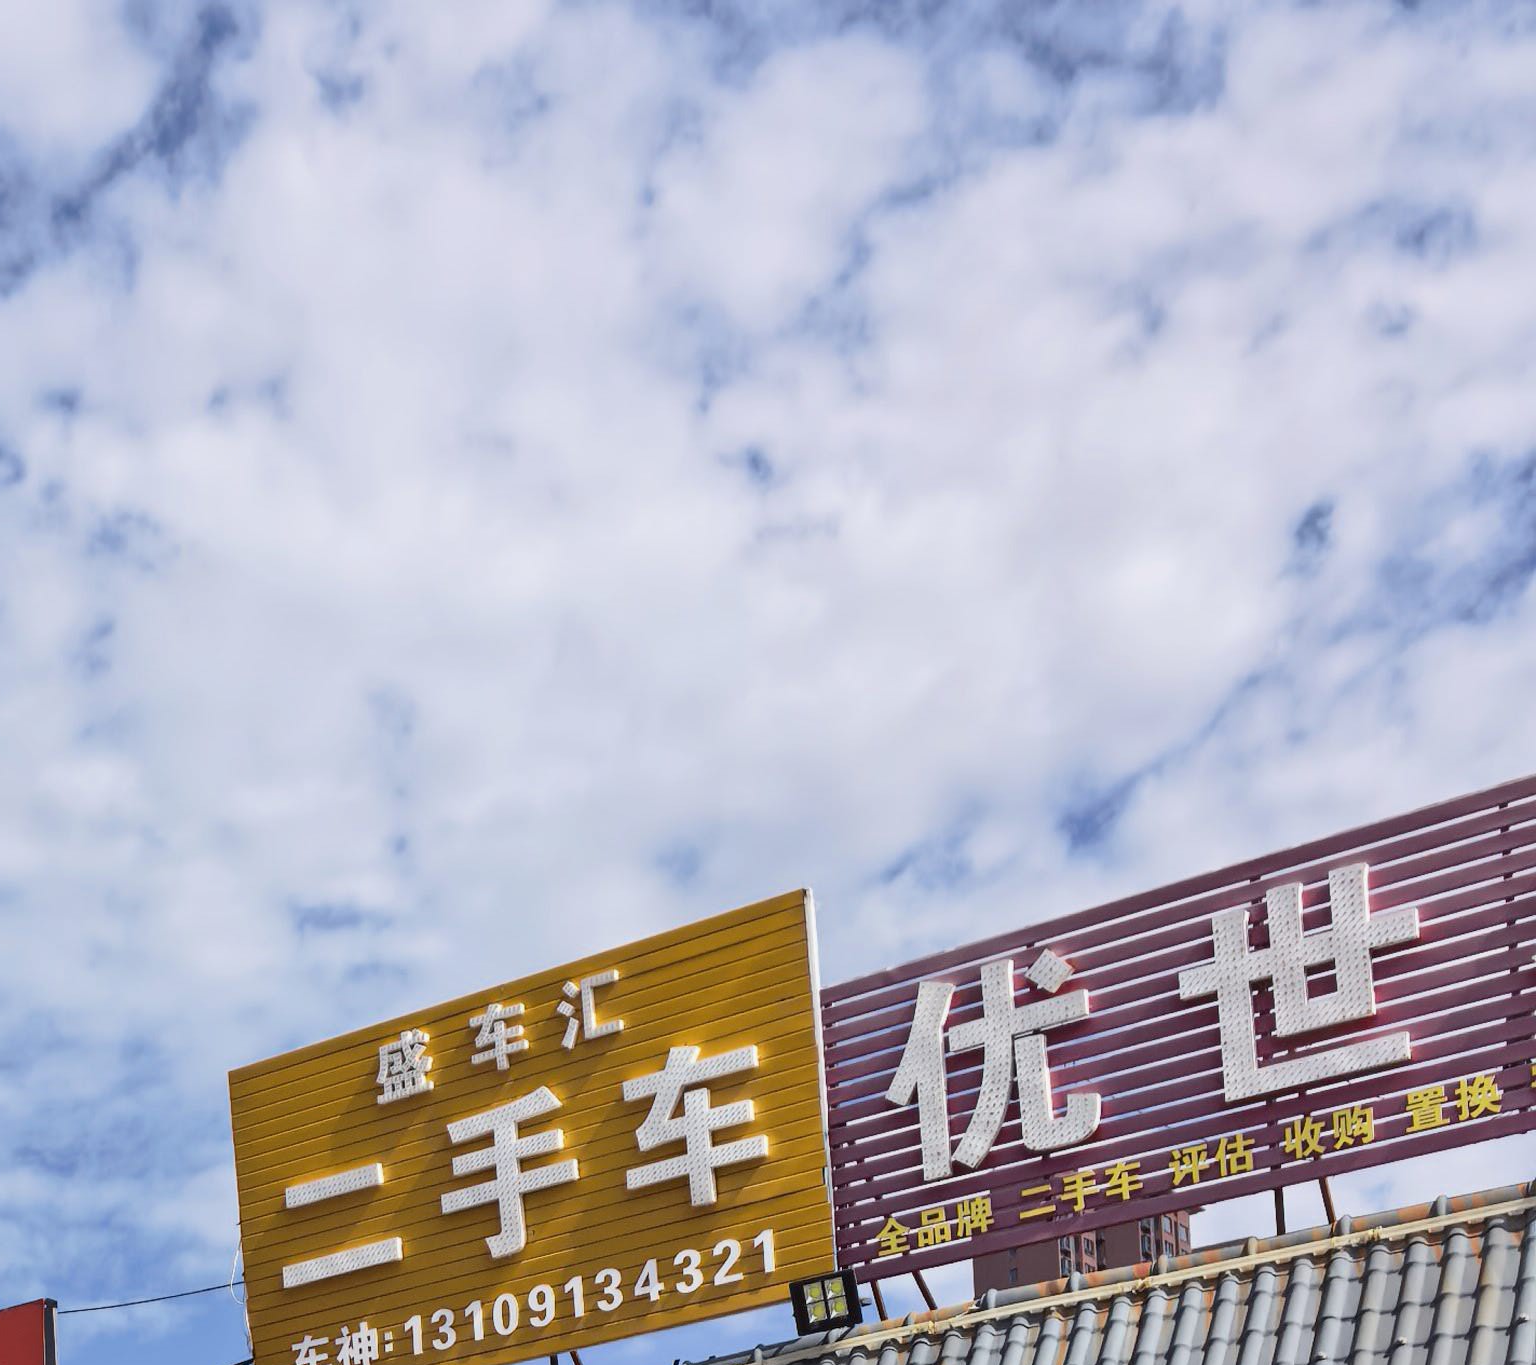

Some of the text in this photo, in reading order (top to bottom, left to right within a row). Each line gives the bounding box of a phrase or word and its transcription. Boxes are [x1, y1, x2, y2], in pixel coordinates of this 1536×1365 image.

[376, 968, 625, 1104] 盛车汇
[885, 862, 1421, 1183] 优世
[282, 1043, 770, 1290] 二手车
[876, 1197, 995, 1258] 全品牌
[1019, 1160, 1145, 1222] 二手车
[1169, 1132, 1257, 1189] 评估
[1283, 1104, 1376, 1161] 收购
[1404, 1072, 1504, 1135] 置换
